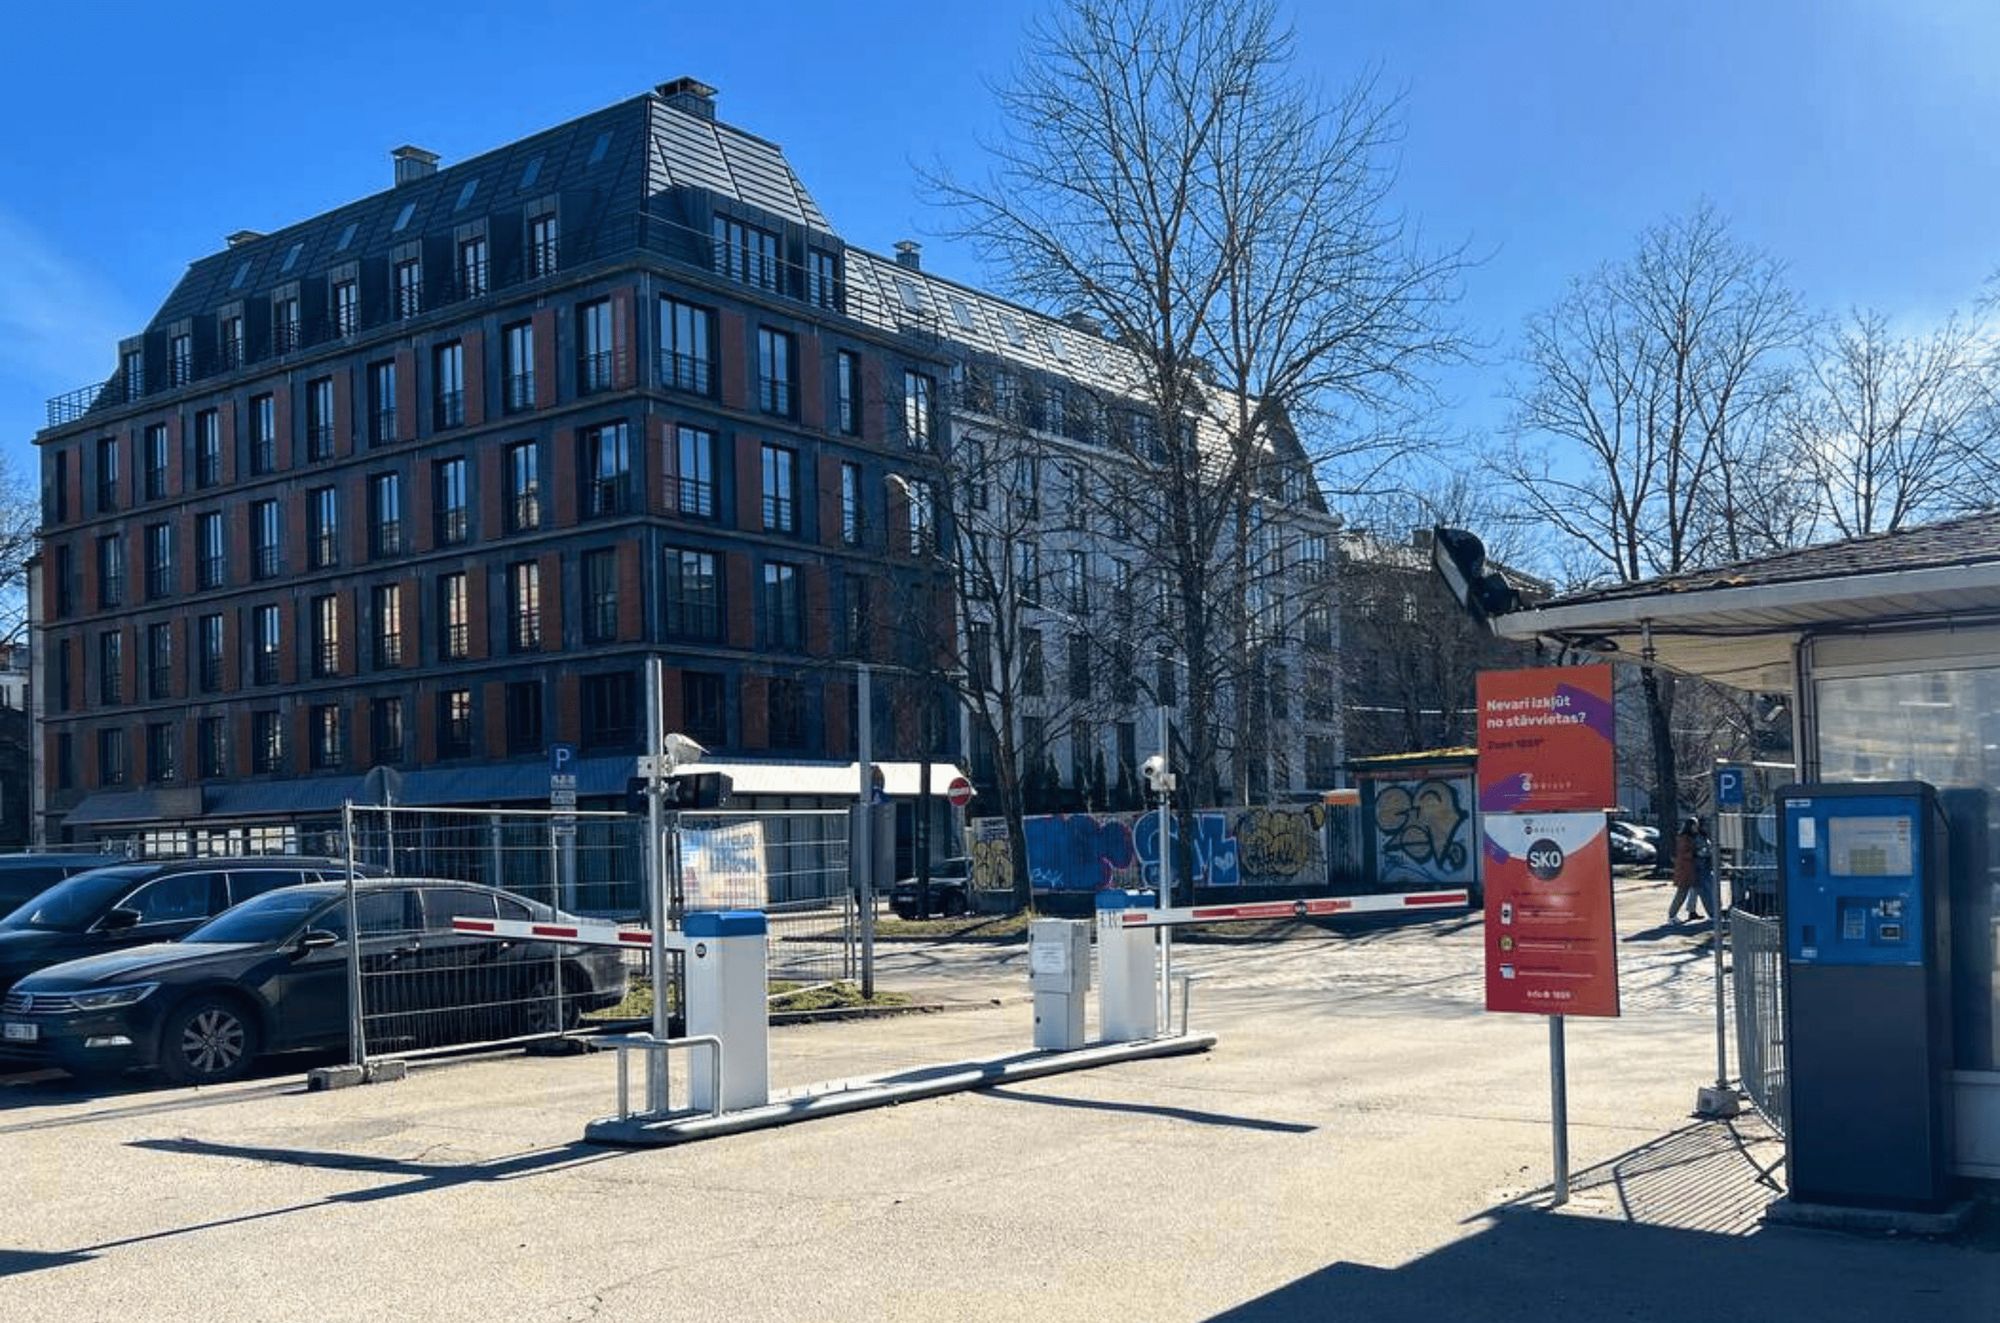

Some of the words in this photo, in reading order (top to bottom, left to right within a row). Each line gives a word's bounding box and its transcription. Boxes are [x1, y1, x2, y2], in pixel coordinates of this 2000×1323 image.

[1487, 718, 1504, 729] no
[1506, 712, 1587, 728] stāvvietas?
[556, 747, 571, 770] P
[1720, 774, 1737, 800] P
